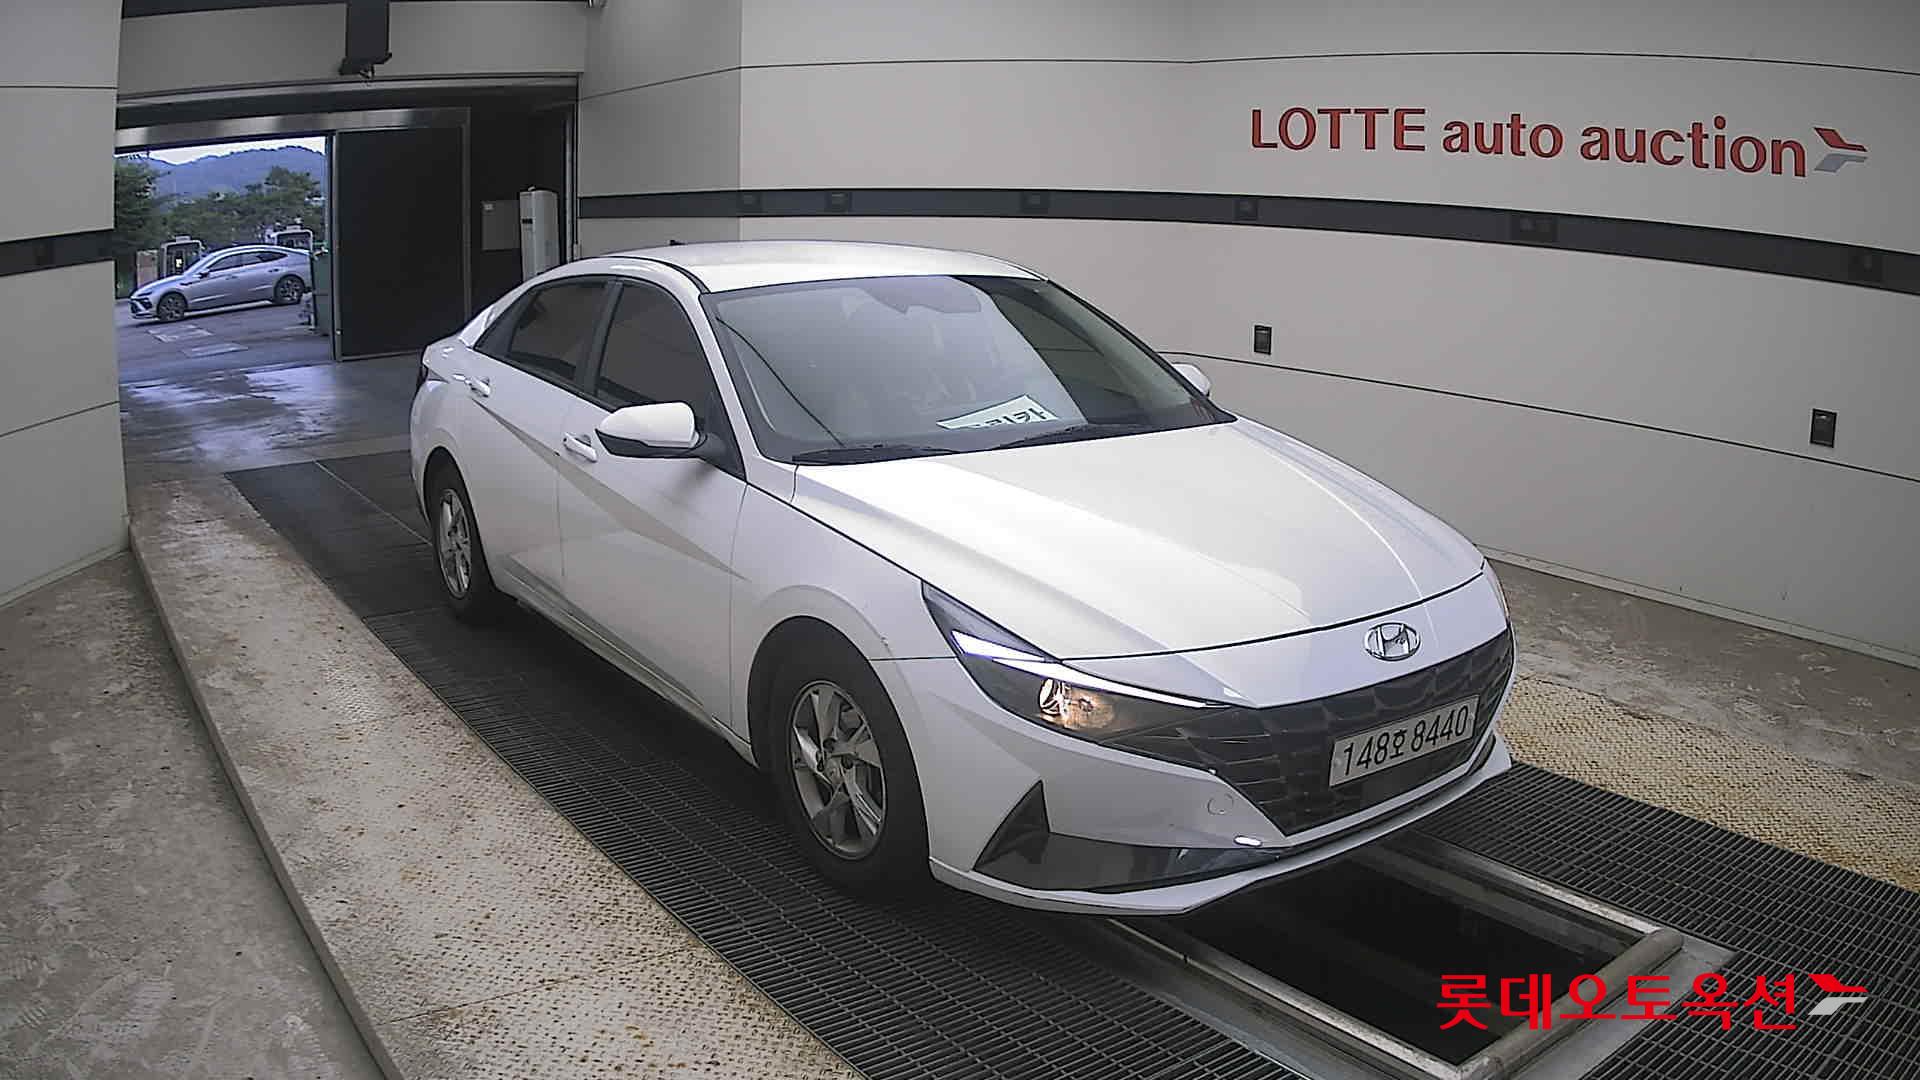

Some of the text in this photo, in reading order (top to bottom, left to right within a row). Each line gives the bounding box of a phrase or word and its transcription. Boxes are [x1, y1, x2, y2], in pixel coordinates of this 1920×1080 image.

[1251, 107, 1807, 178] LOTTE auto auction
[1410, 705, 1469, 752] 8440
